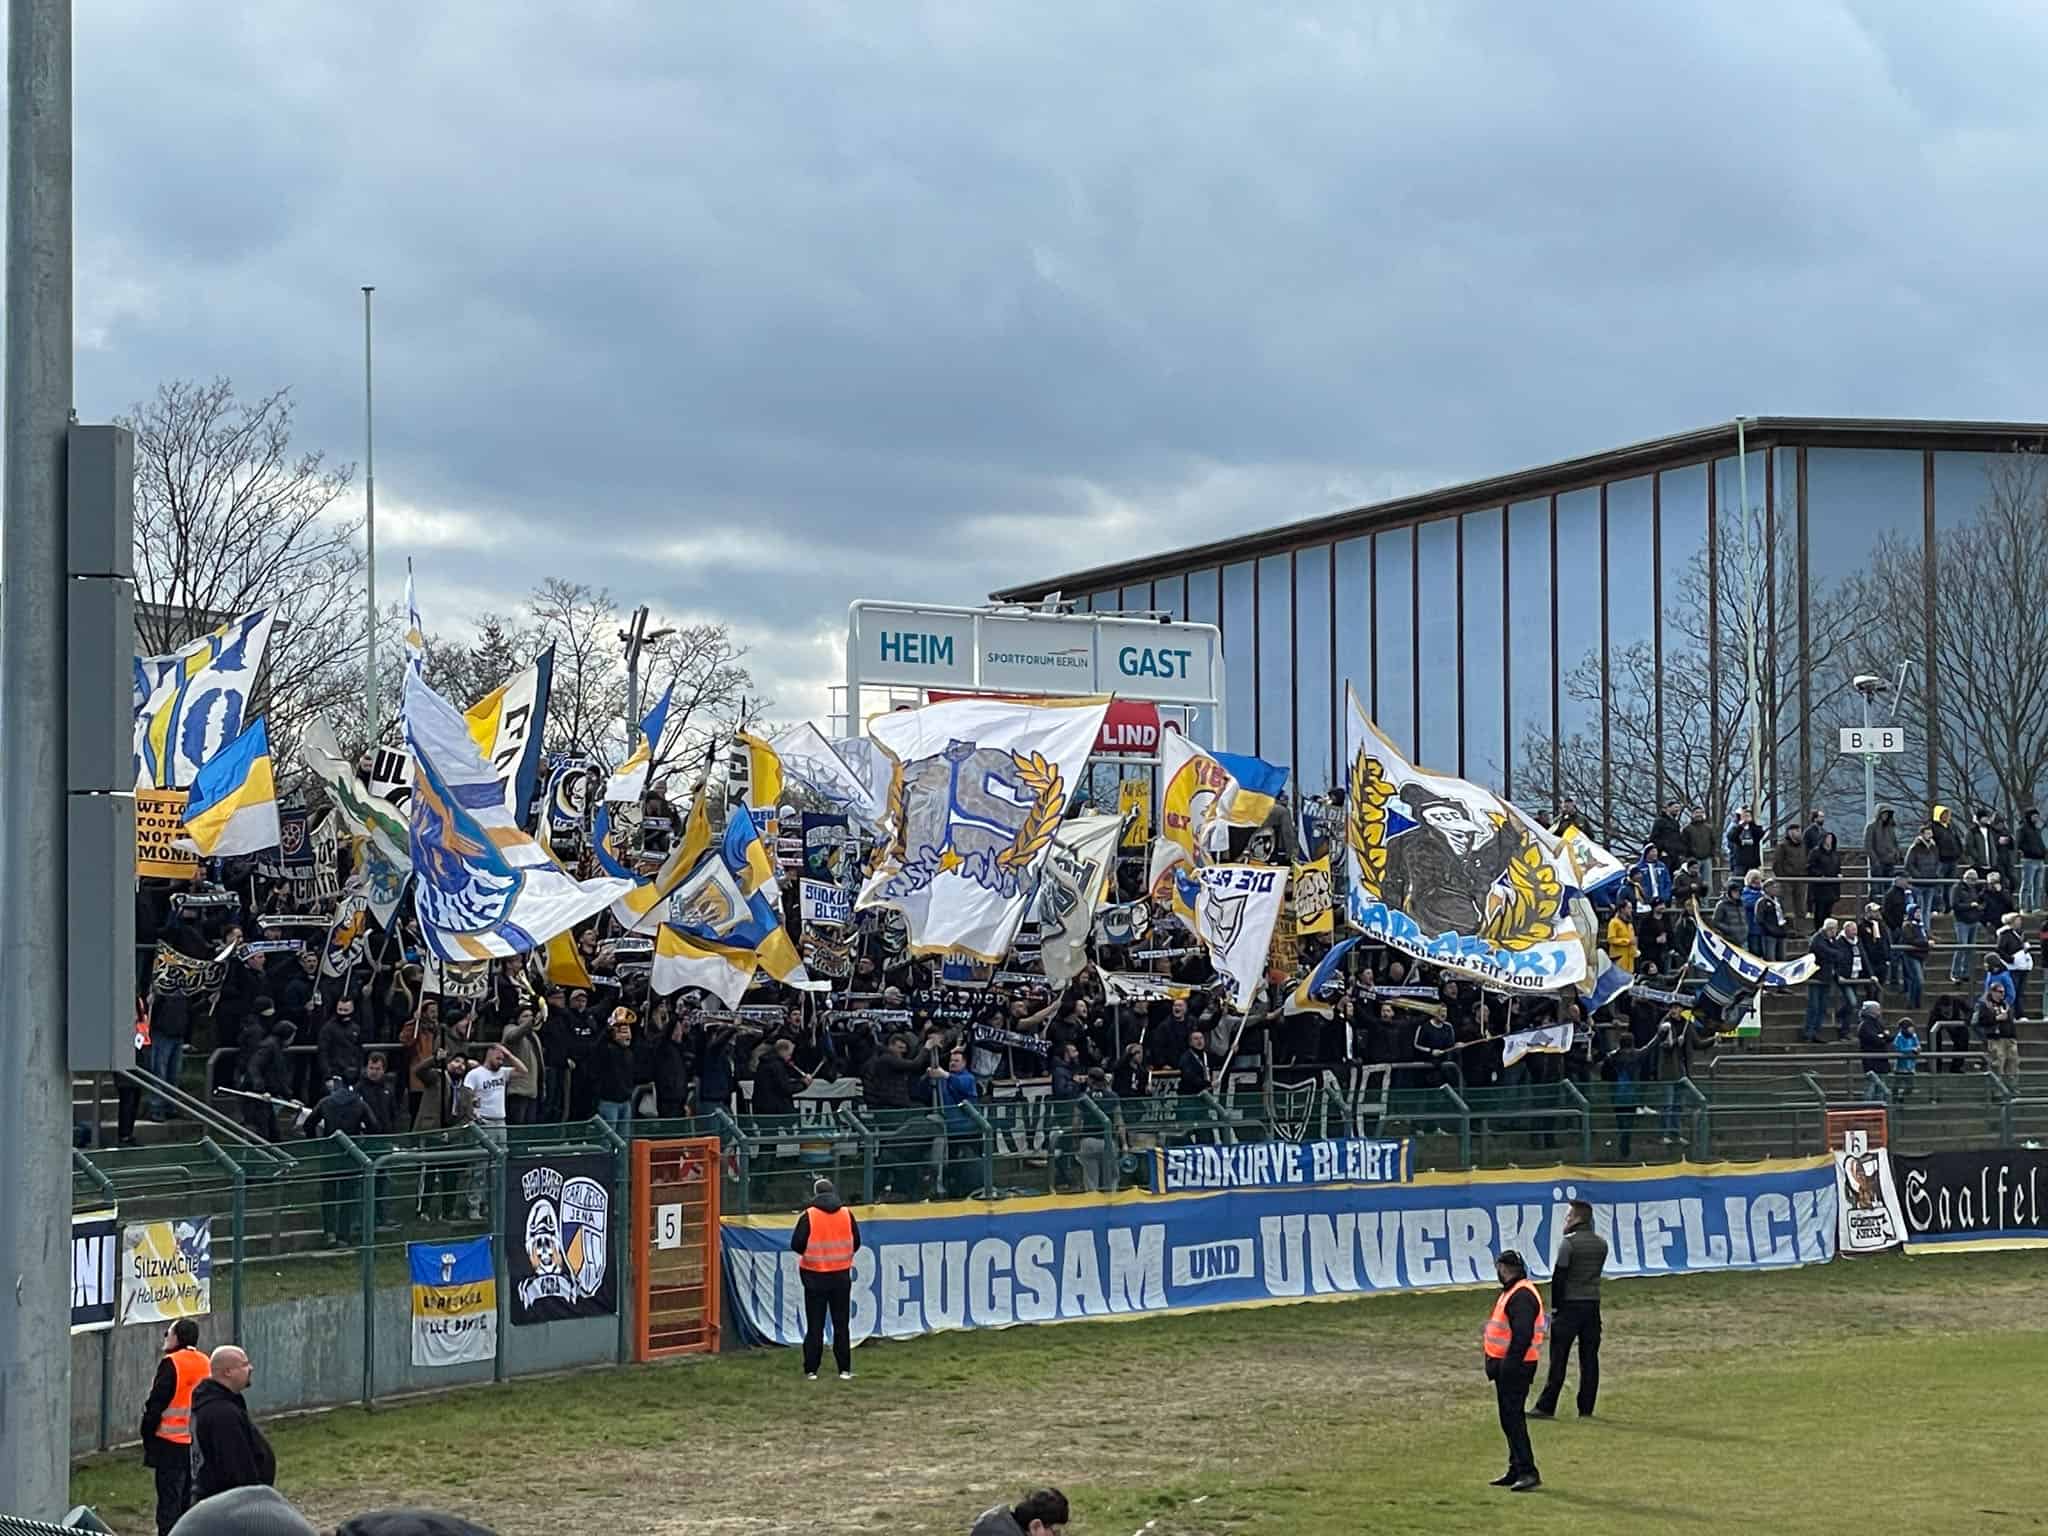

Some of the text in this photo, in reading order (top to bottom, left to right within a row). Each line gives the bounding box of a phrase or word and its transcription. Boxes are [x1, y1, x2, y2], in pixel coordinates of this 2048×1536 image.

[880, 631, 953, 666] HEIM
[987, 652, 1089, 668] SPORTFORUM BERLIN
[1119, 646, 1192, 679] GAST
[1852, 732, 1894, 748] B B
[137, 802, 187, 815] WE LO
[138, 831, 171, 844] NOT
[815, 902, 850, 920] BLEIB
[1312, 1141, 1399, 1181] BLEIBT
[570, 1208, 595, 1225] JENA
[665, 1213, 675, 1240] 5
[72, 1235, 116, 1308] NI
[1188, 1245, 1240, 1279] UND
